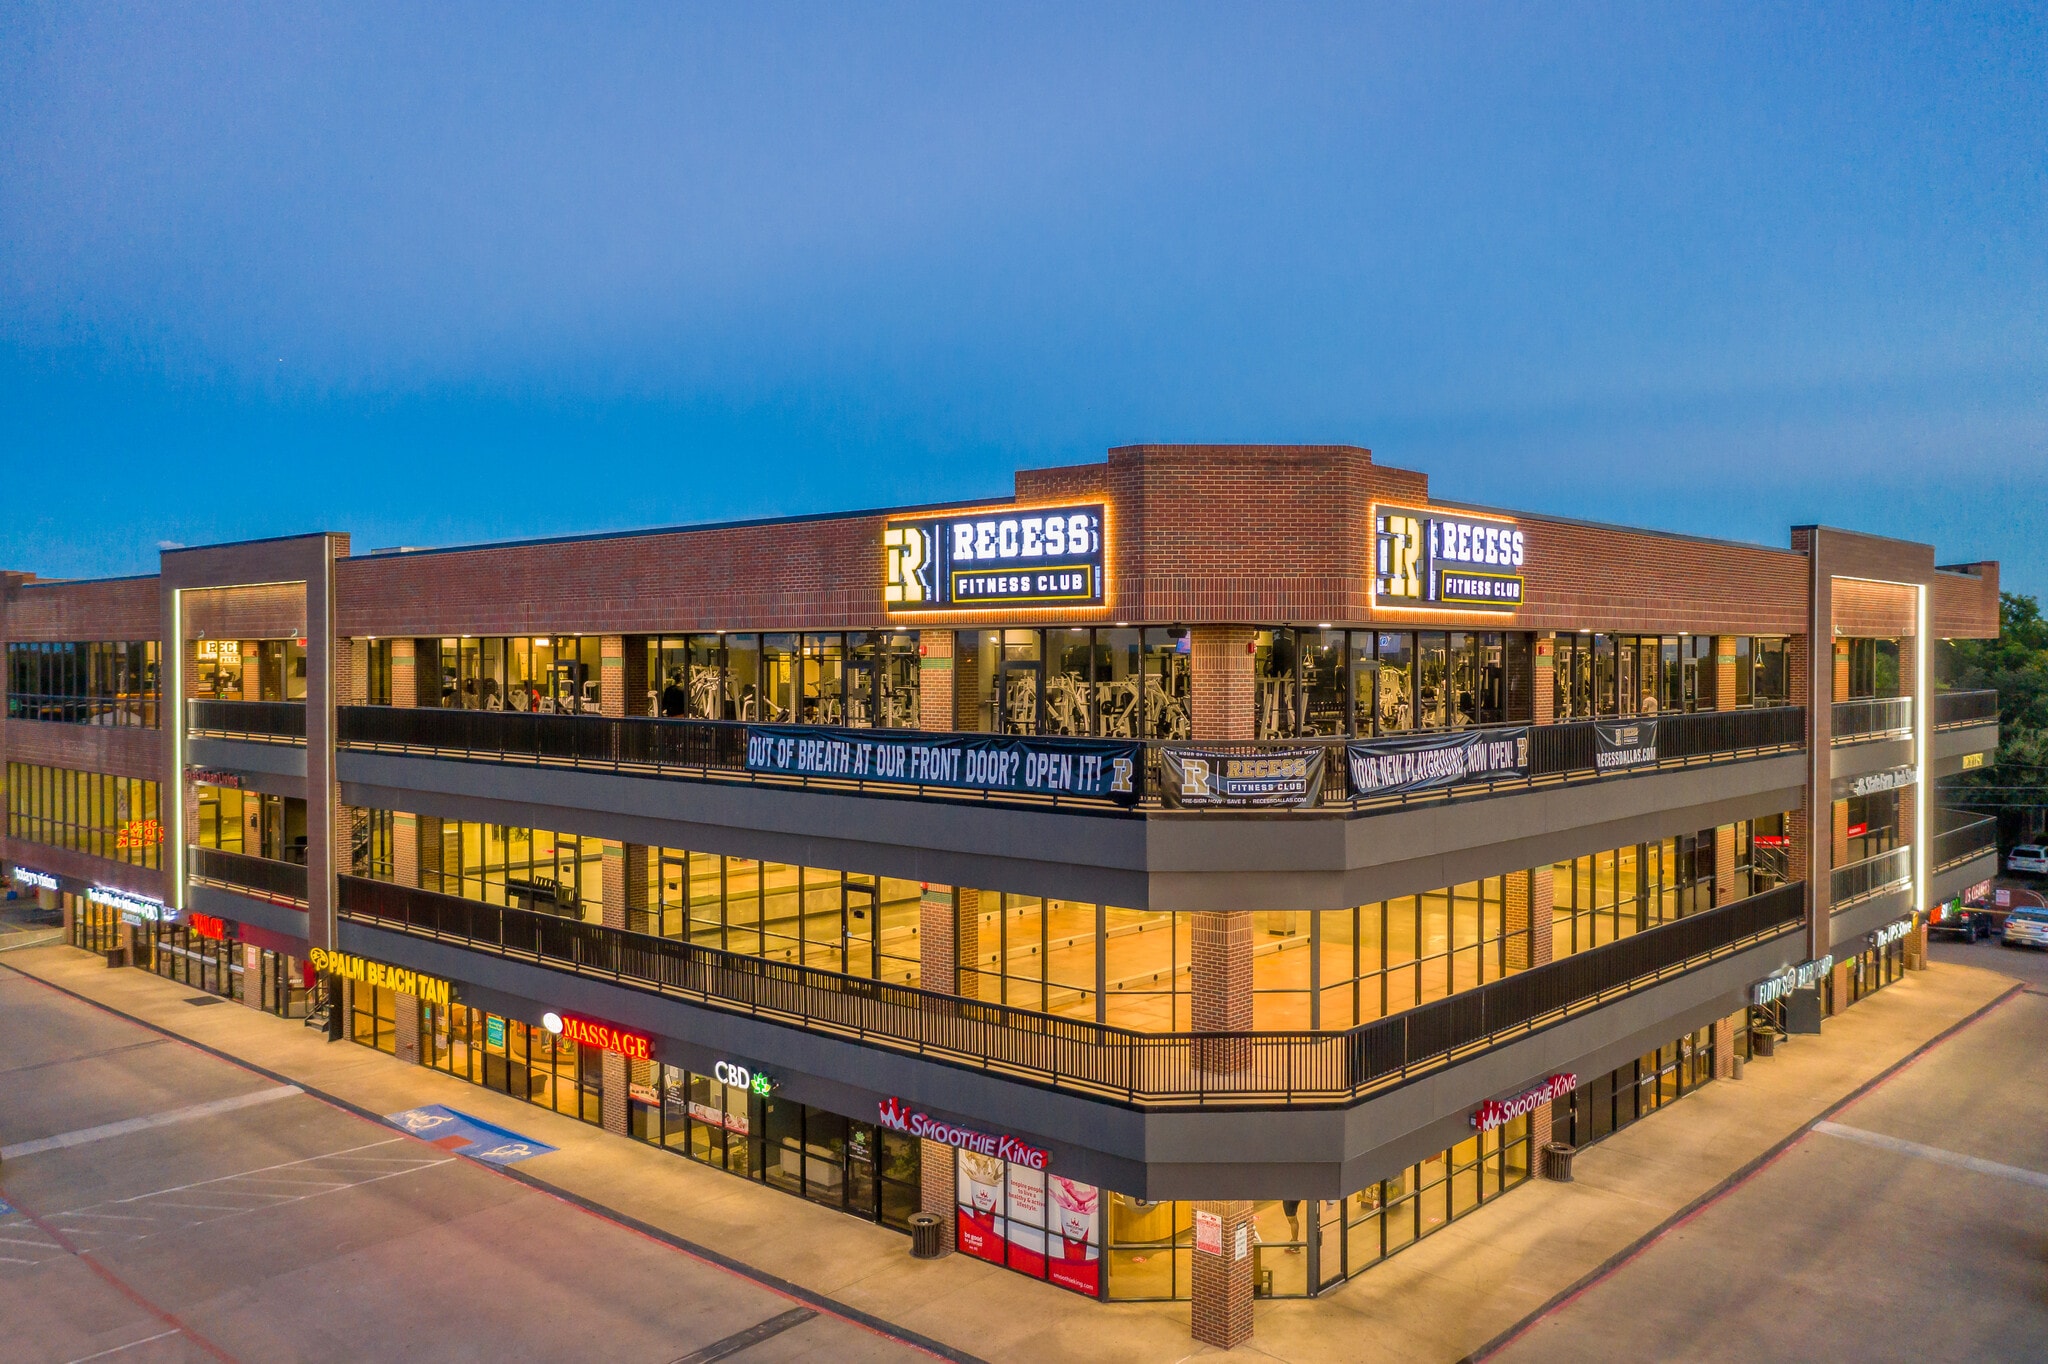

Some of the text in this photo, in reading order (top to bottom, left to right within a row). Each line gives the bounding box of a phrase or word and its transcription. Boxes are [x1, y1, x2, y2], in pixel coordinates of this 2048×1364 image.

[953, 514, 1091, 560] RECESS
[1442, 521, 1523, 566] RECESS
[959, 574, 1083, 594] FITNESS CLUB
[1446, 578, 1520, 598] FITNESS CLUB
[750, 736, 1102, 792] OUT OF BREATH AT OUR FRONT DOOR? OPEN IT!
[1227, 758, 1307, 778] RECESS
[1351, 741, 1514, 789] YOUR NEW PLAYGROUND, NOW OPEN!
[1597, 747, 1656, 767] RECESSDALLAS.COM
[1231, 782, 1302, 792] FITNESS CLUB
[328, 951, 448, 1004] PALM BEACH TAN
[562, 1016, 649, 1059] MASSAGE
[715, 1060, 750, 1089] CBD
[1502, 1085, 1553, 1124] SMOOTHIE
[910, 1114, 996, 1156] SMOOTHIE
